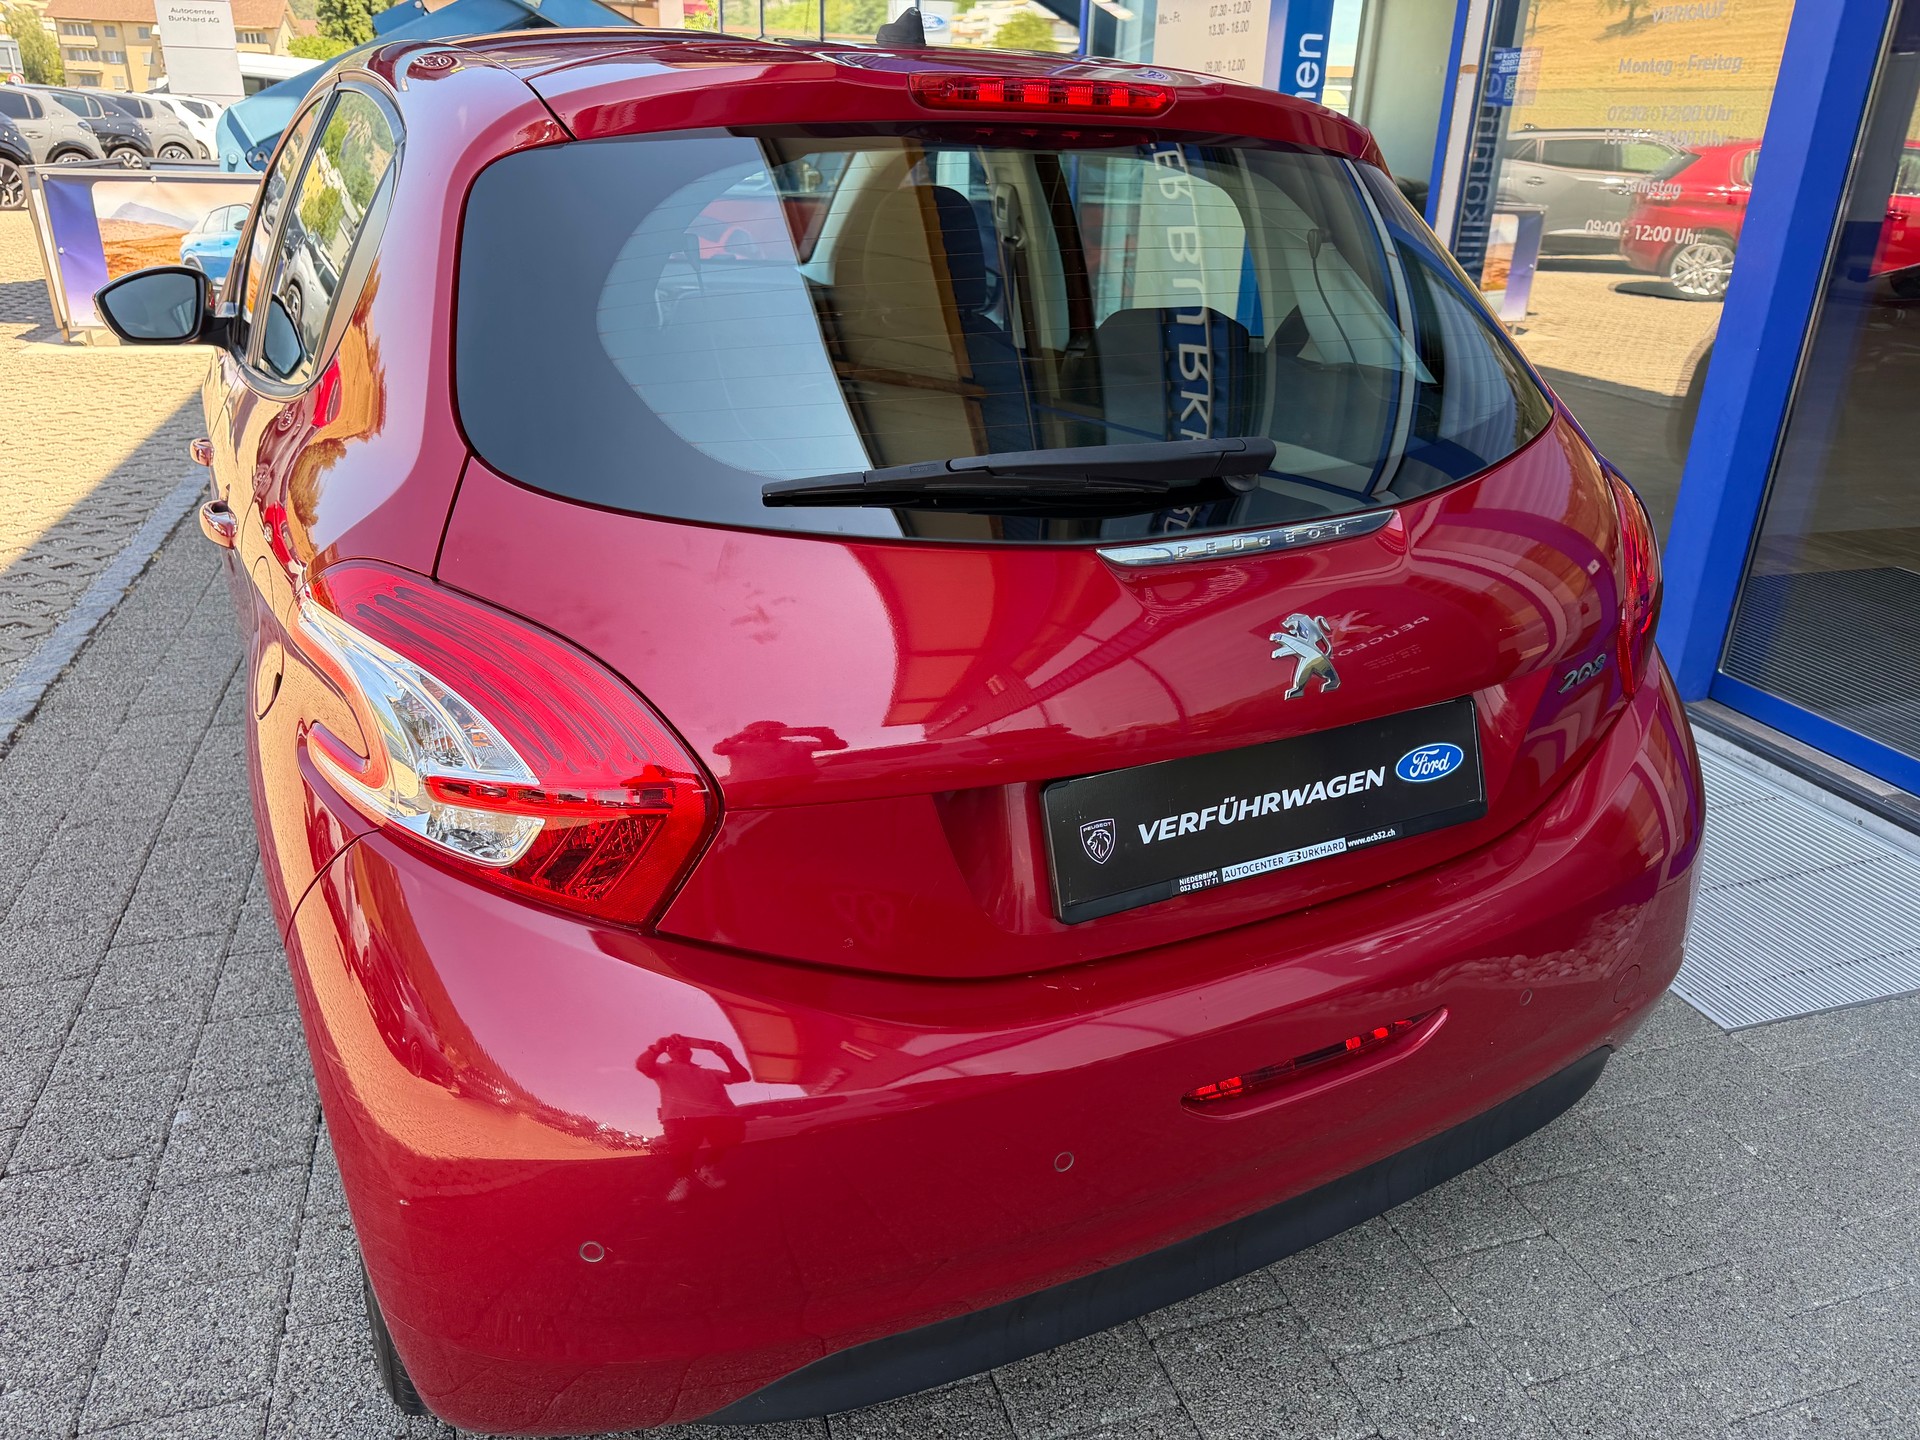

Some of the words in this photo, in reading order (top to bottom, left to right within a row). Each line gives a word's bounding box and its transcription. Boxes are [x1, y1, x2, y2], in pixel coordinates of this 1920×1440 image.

[168, 15, 206, 23] Burkhard
[170, 7, 215, 15] Autocenter
[1618, 58, 1674, 76] Montag
[1687, 54, 1744, 74] Freitag
[1622, 180, 1682, 200] Samstag
[1585, 219, 1621, 236] 09:00
[1635, 224, 1671, 243] 12:00
[1675, 228, 1702, 245] Uhr
[1177, 523, 1345, 559] PEUGEOT
[1557, 653, 1607, 695] 208
[1409, 749, 1450, 778] Ford
[1137, 766, 1386, 845] VERFÜHRWAGEN
[1083, 822, 1112, 832] PEUGEOT
[1224, 857, 1285, 880] AUTOCENTER
[1347, 829, 1396, 848] www.acb32.ch
[1179, 870, 1218, 886] NIEDERBIPP
[1180, 884, 1191, 892] 032
